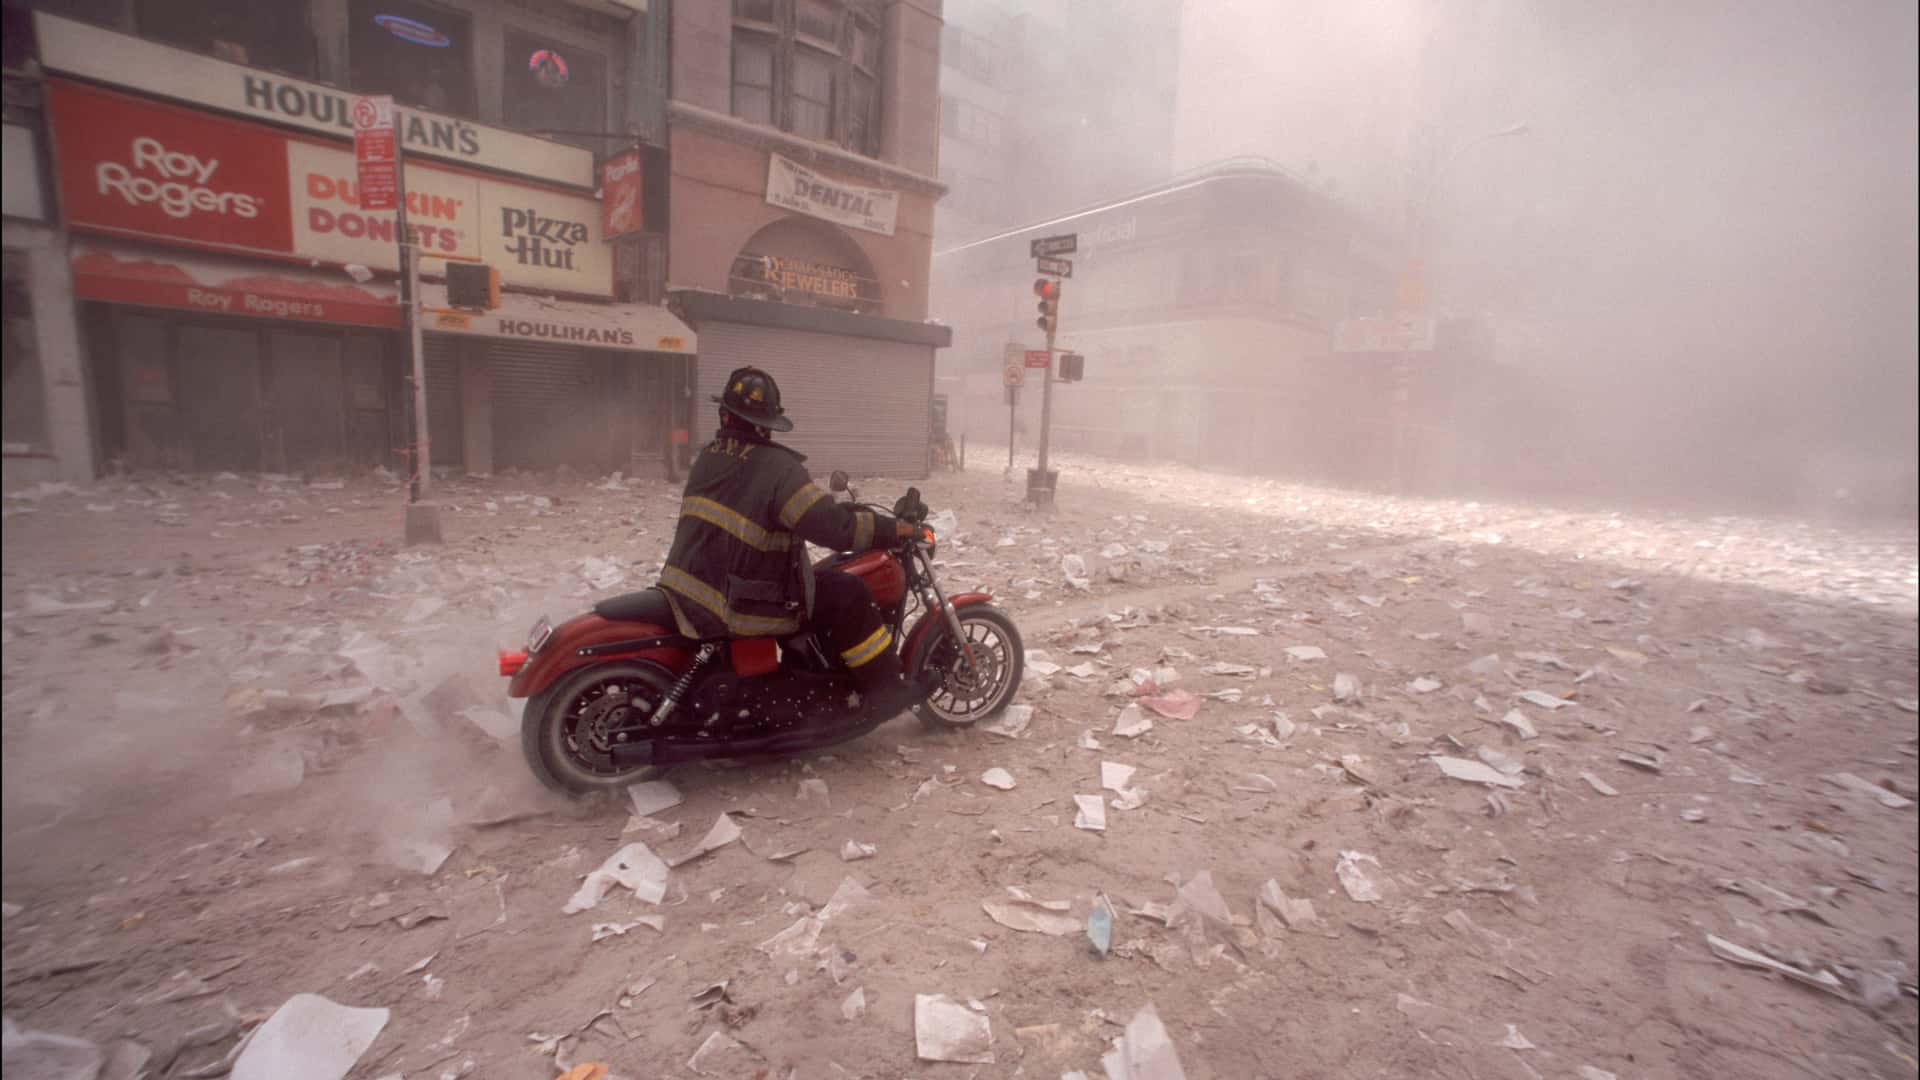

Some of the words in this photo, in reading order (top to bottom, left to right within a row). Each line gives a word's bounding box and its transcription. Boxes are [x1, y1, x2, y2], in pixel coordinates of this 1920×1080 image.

[243, 74, 480, 156] HOULAN'S
[133, 137, 219, 184] Roy
[96, 162, 258, 218] Rogers
[306, 172, 463, 221] DUKIN'
[793, 177, 875, 217] DENTAL
[501, 206, 589, 246] Pizza
[504, 235, 576, 270] Hut
[188, 288, 232, 311] Roy
[244, 294, 324, 317] Rogers
[780, 270, 858, 298] JEWELERS
[498, 318, 634, 345] HOULIHAN'S
